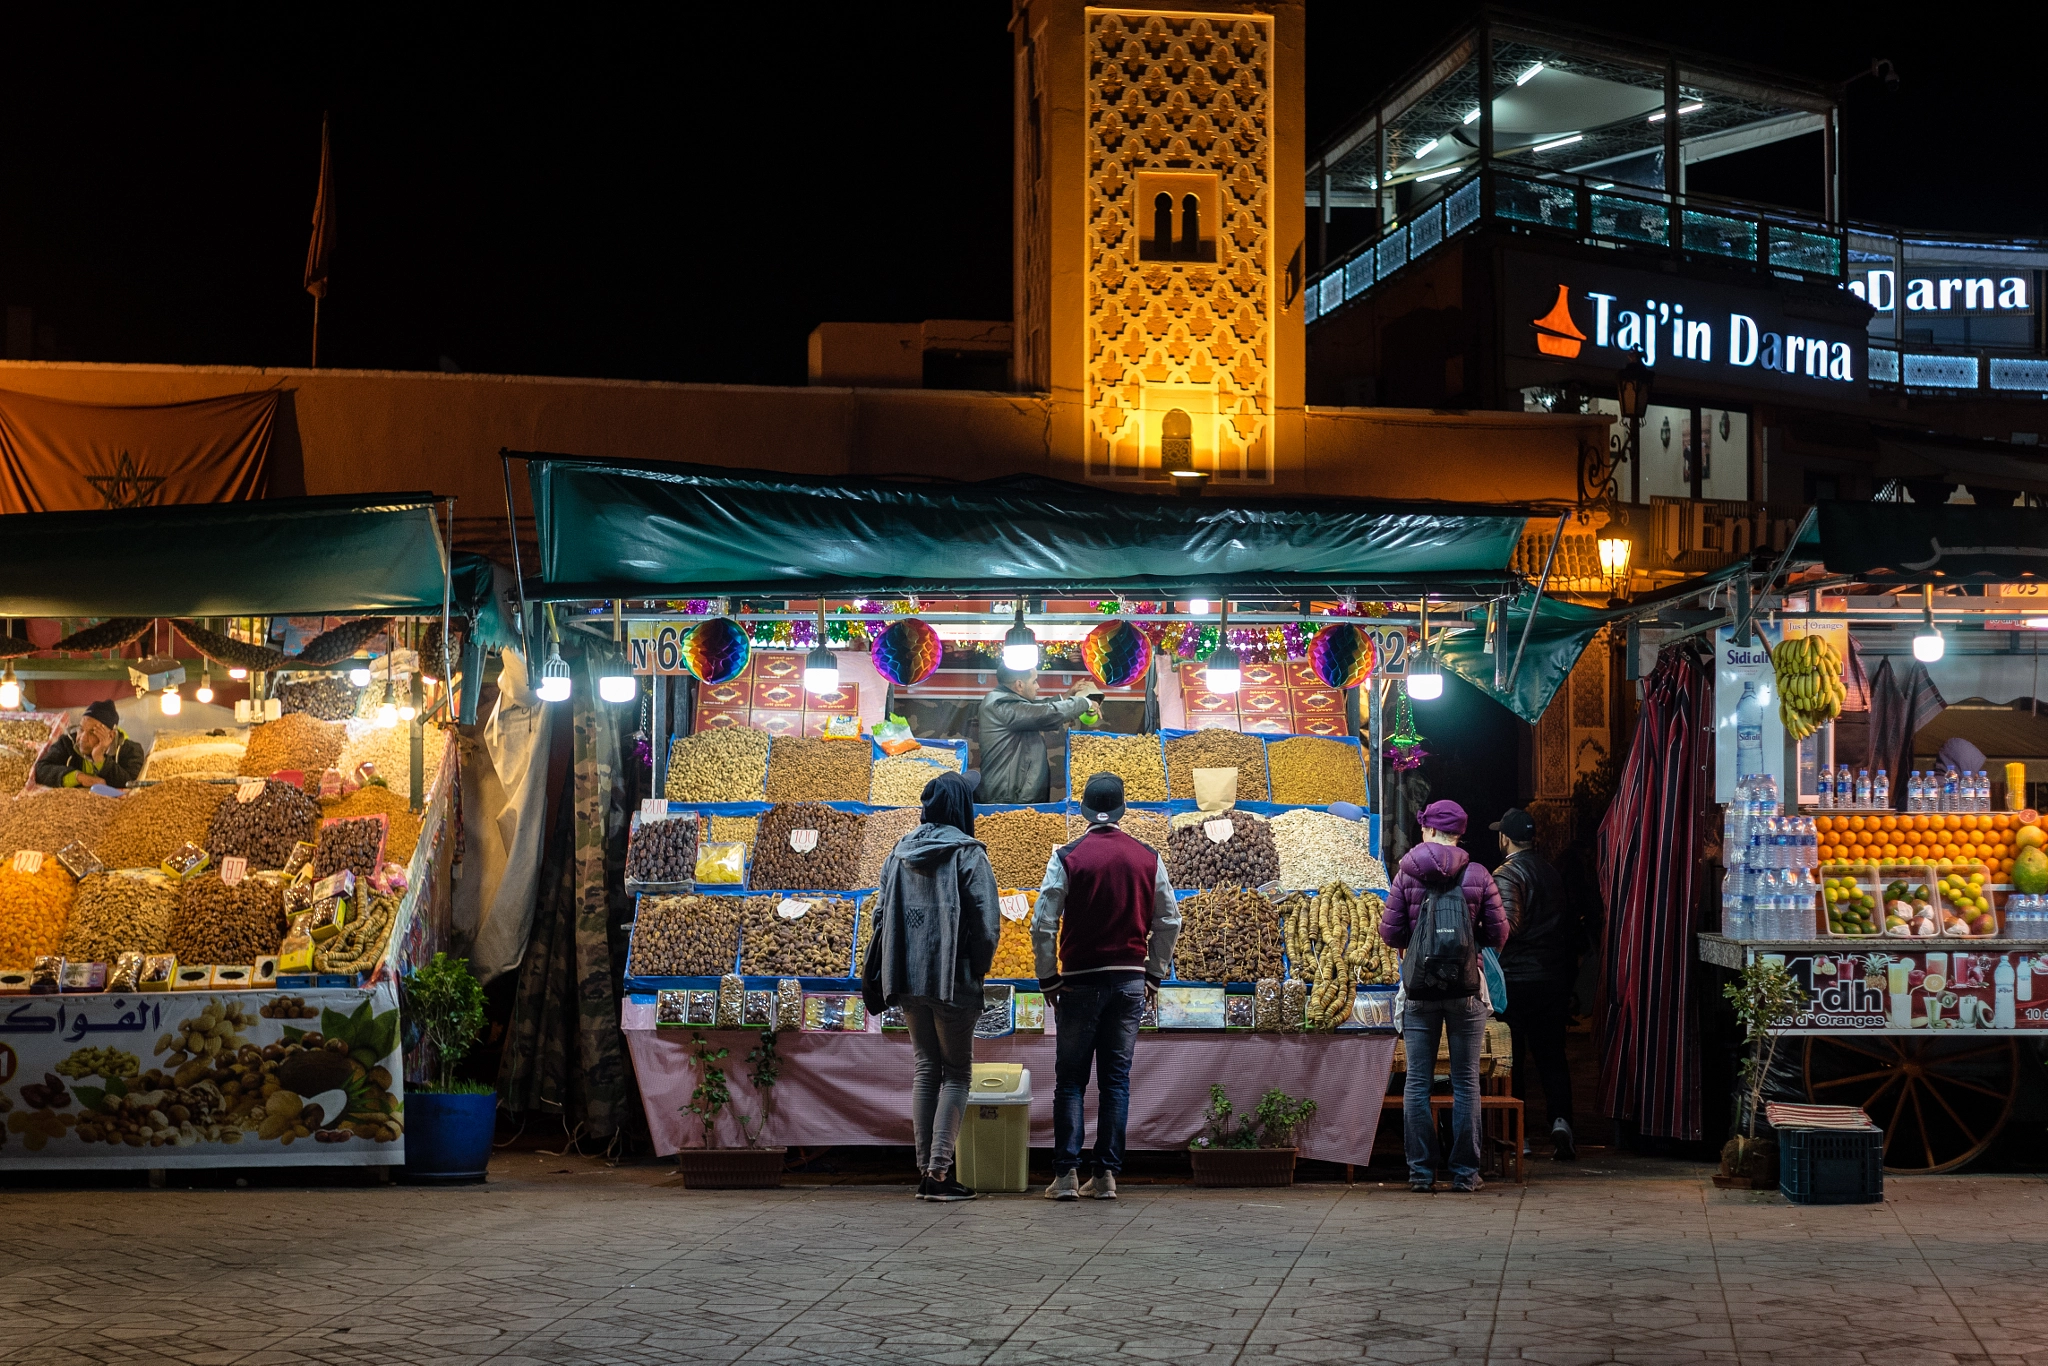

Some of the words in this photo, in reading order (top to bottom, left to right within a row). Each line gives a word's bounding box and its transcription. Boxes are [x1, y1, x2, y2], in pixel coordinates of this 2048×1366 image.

[1867, 269, 2030, 311] Darna
[1729, 312, 1855, 382] Darna
[1788, 621, 1801, 631] Jus
[1727, 649, 1751, 665] Sidi
[1753, 650, 1769, 664] ali
[1739, 733, 1751, 741] Sidi
[226, 860, 244, 880] 80
[1000, 894, 1027, 915] 120
[2025, 1008, 2041, 1020] 10
